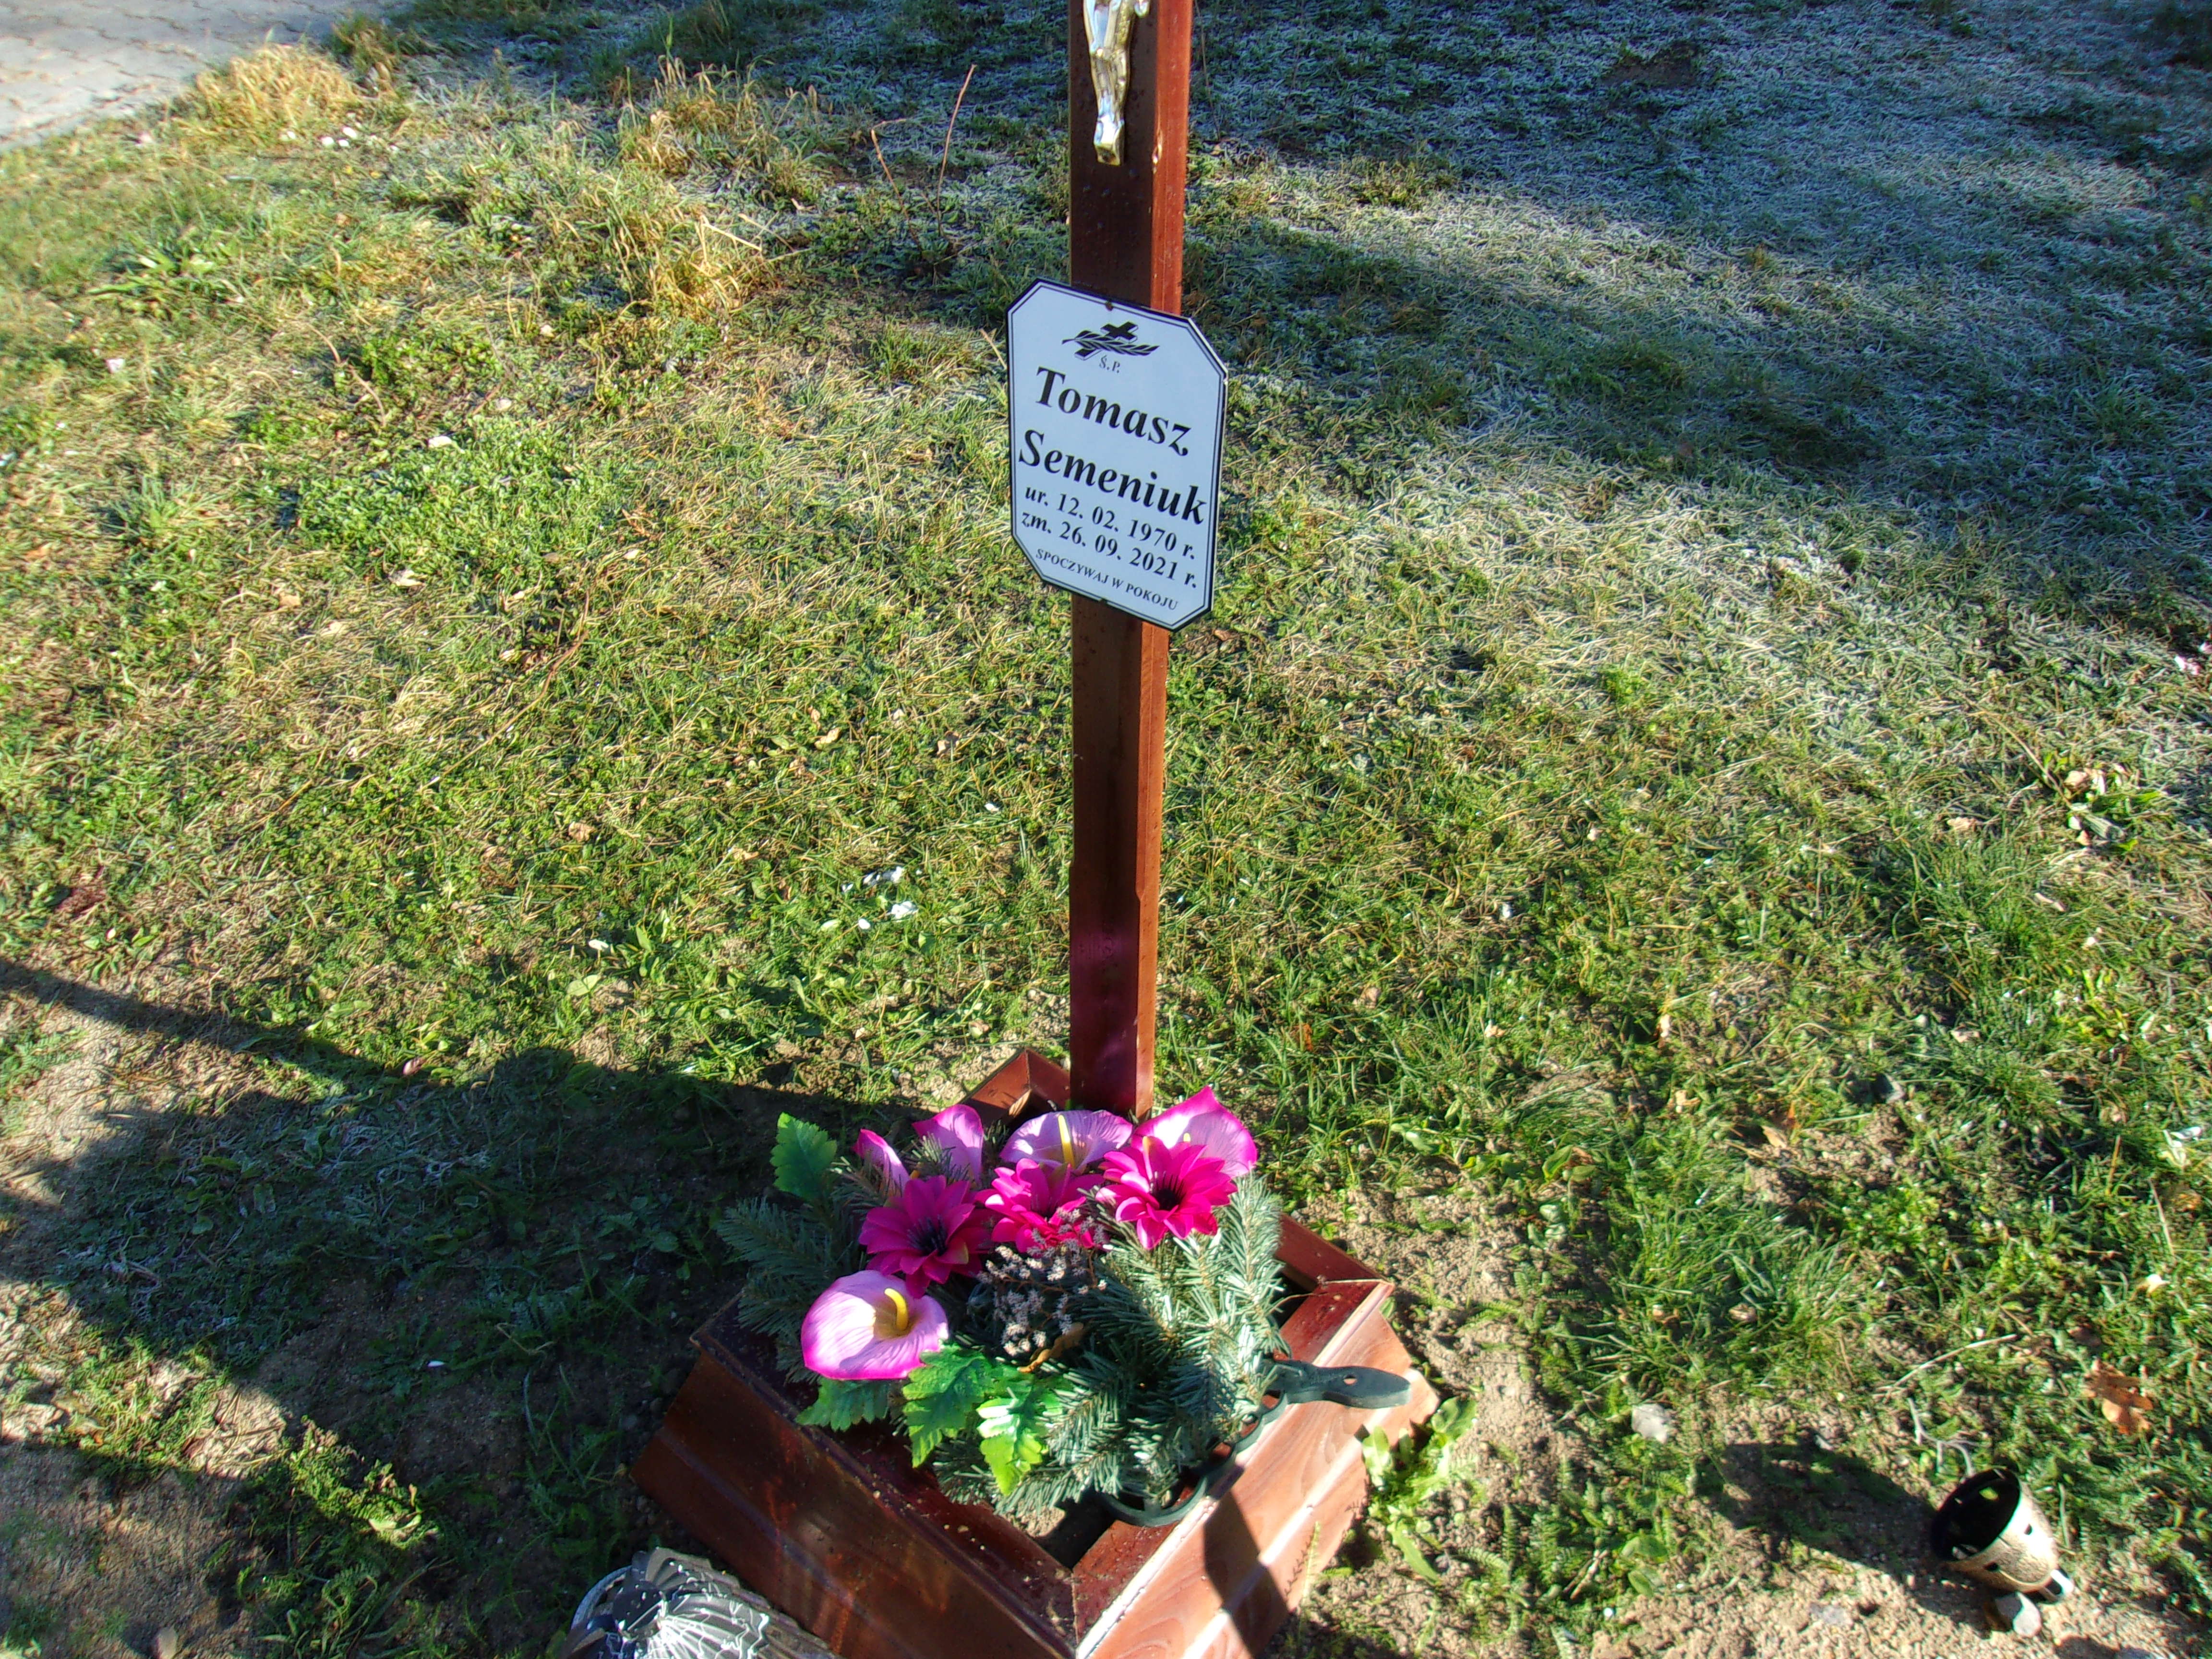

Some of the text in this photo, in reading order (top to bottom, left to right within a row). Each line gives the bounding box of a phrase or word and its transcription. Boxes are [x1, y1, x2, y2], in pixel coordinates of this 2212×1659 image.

[1036, 367, 1191, 456] Tomasz
[1019, 430, 1206, 525] Semeniuk
[1022, 512, 1196, 589] zm. 26. 09. 2021 r.
[1025, 487, 1195, 560] ur. 12. 02. 1970 r.
[1035, 549, 1178, 611] SPOCZYWAJ W POKOJU
